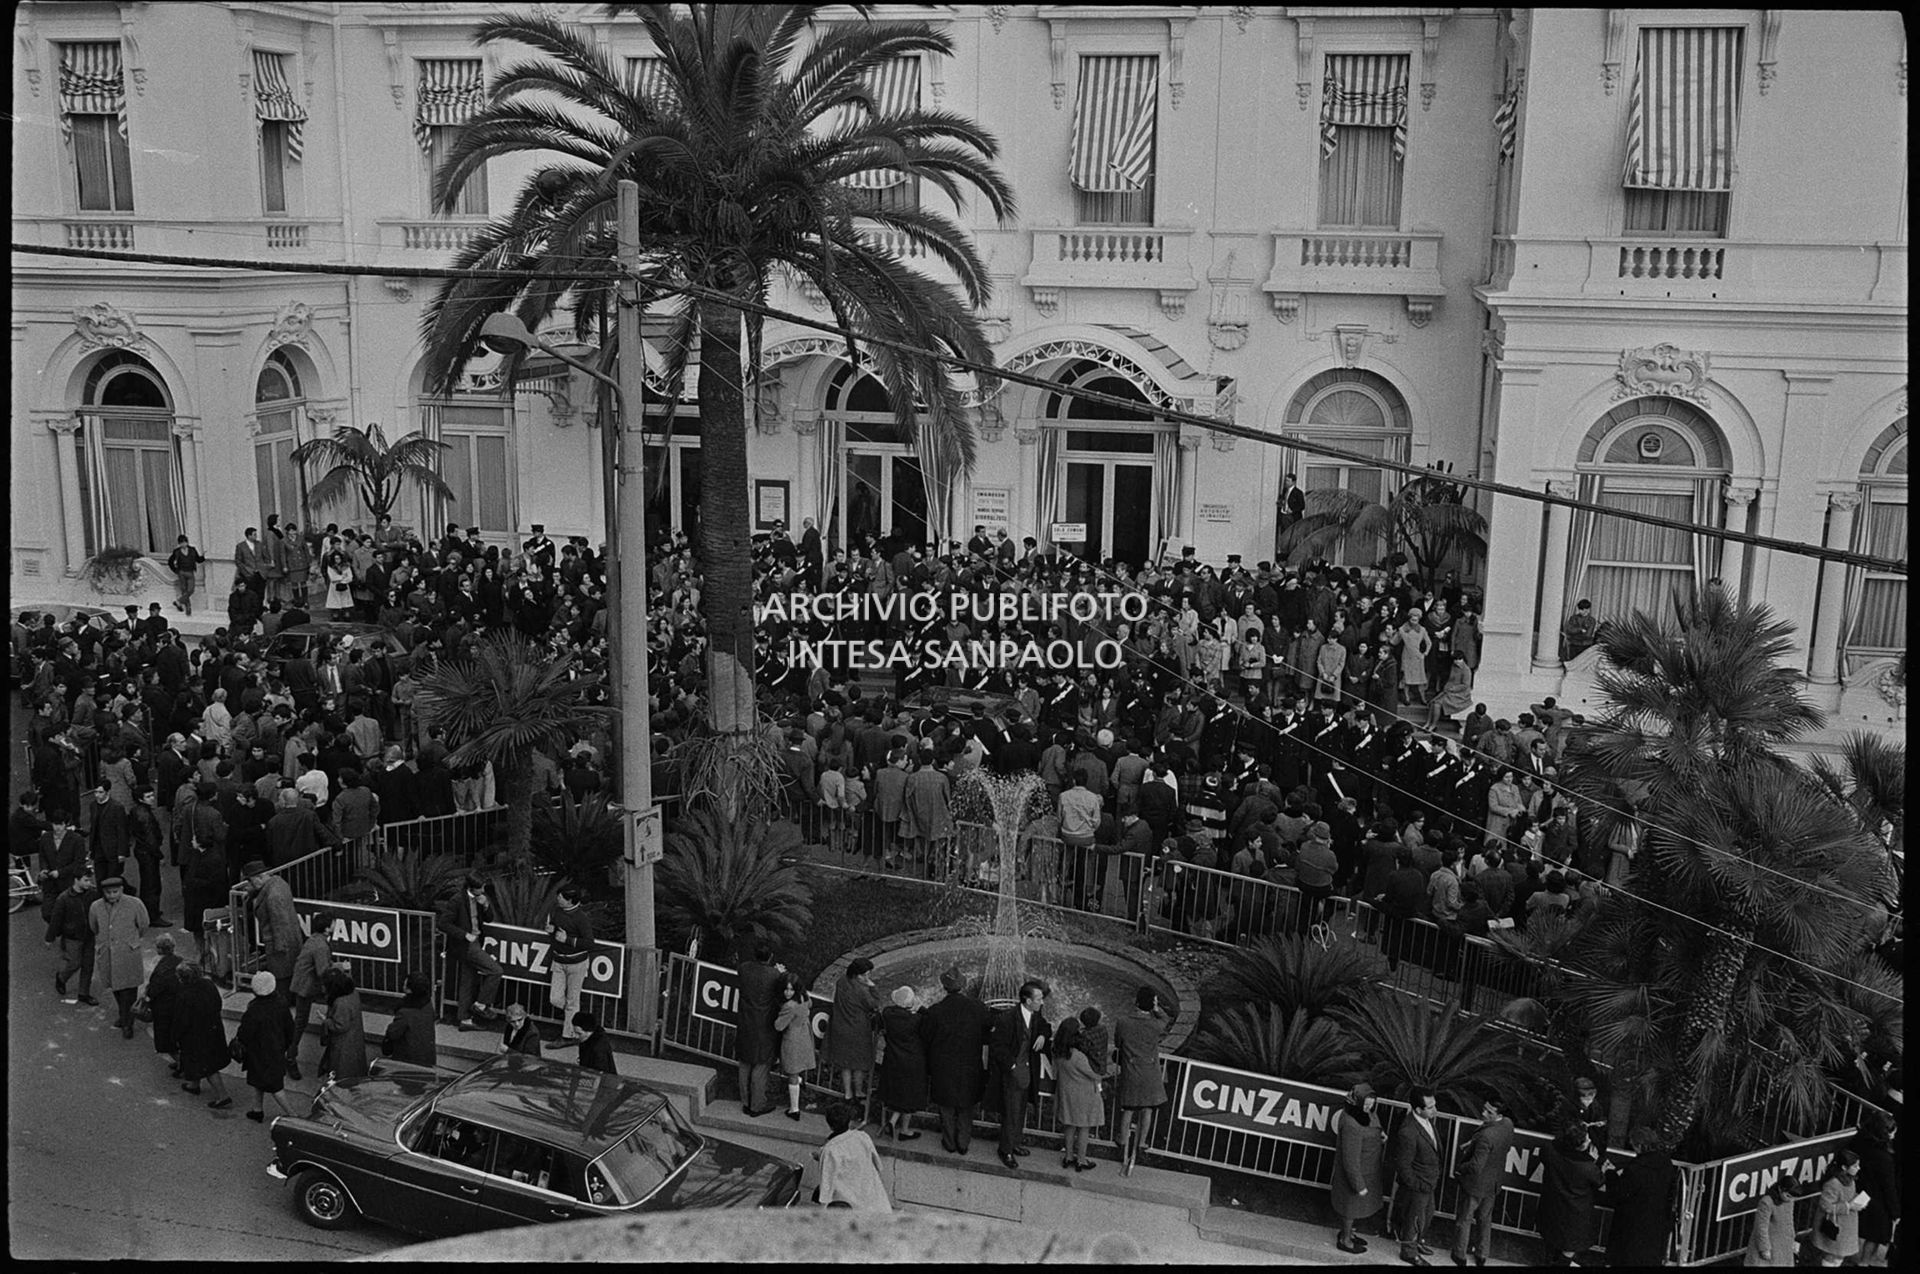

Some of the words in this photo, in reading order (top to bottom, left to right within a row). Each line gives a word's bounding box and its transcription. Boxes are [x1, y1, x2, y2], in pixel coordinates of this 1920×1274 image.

[297, 911, 391, 948] NANO
[481, 936, 614, 982] CINZO
[1728, 1152, 1835, 1203] CINZAN
